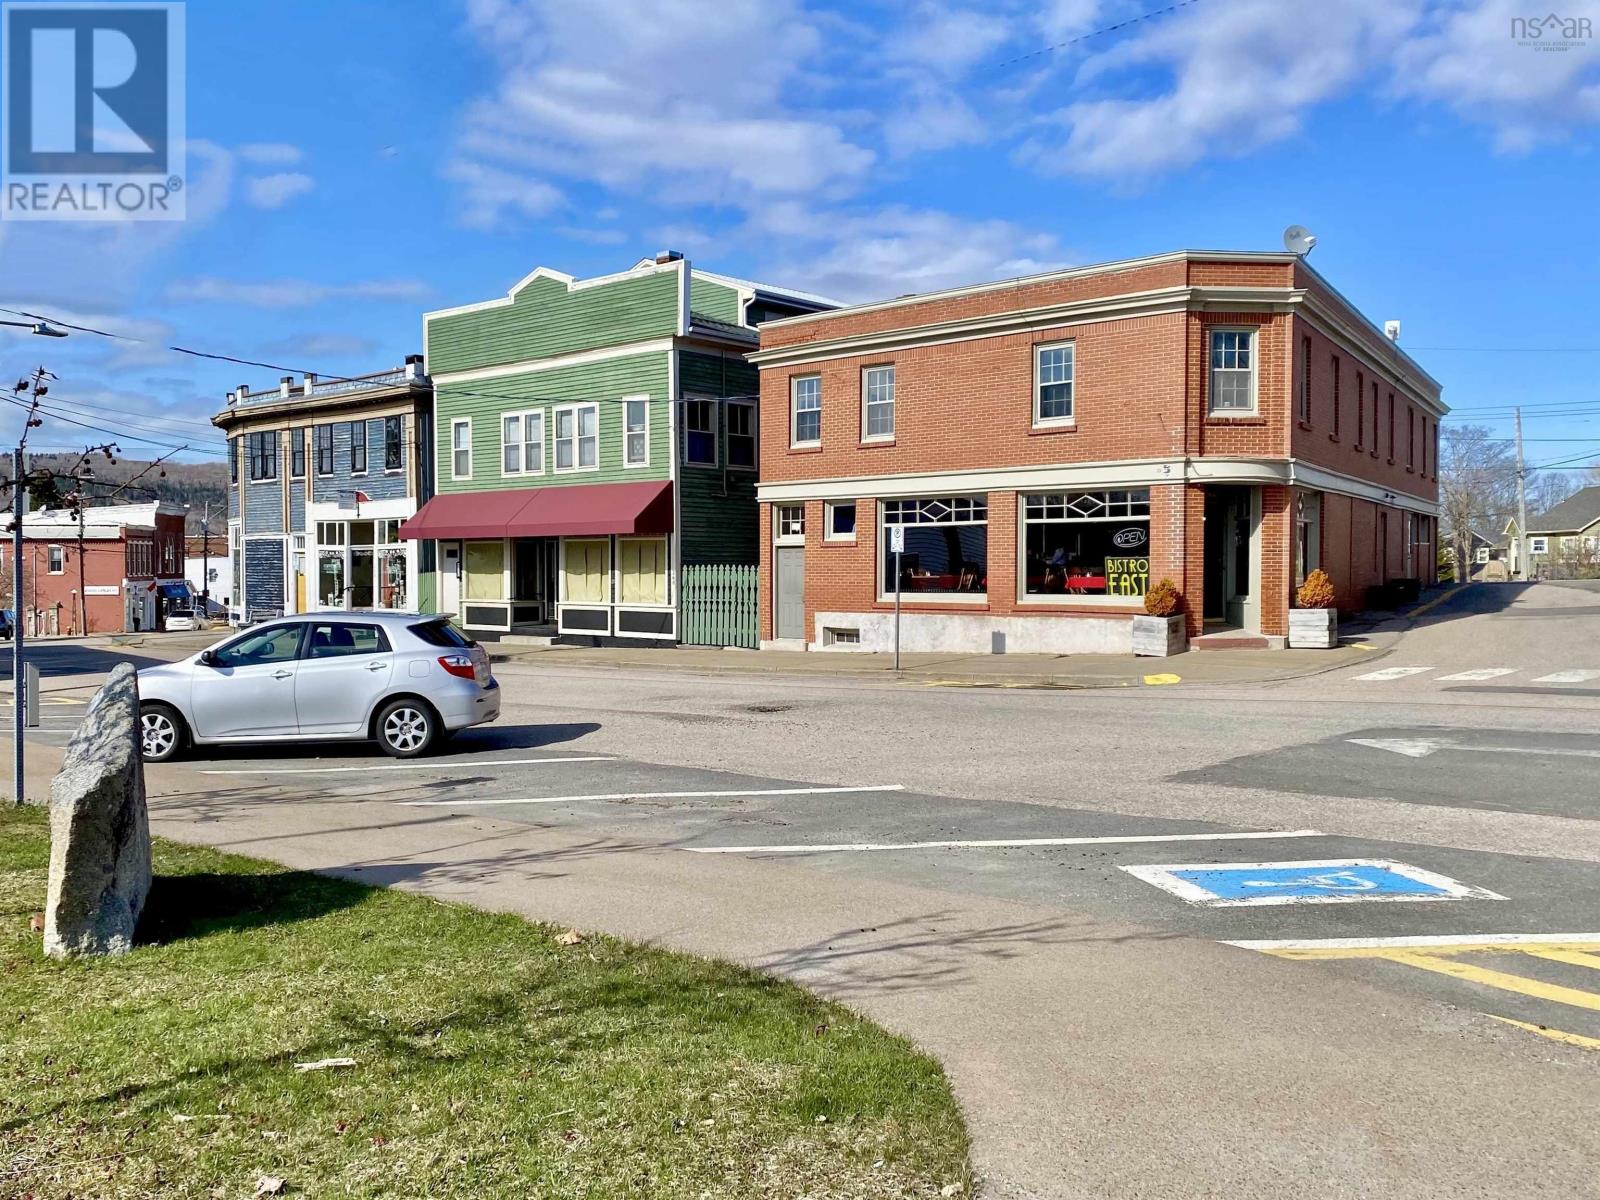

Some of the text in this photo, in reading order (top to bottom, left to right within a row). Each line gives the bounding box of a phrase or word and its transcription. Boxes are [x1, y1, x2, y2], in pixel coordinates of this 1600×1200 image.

[1115, 530, 1146, 543] OPEN
[1107, 559, 1149, 573] BISTRO
[1108, 573, 1149, 596] EAST
